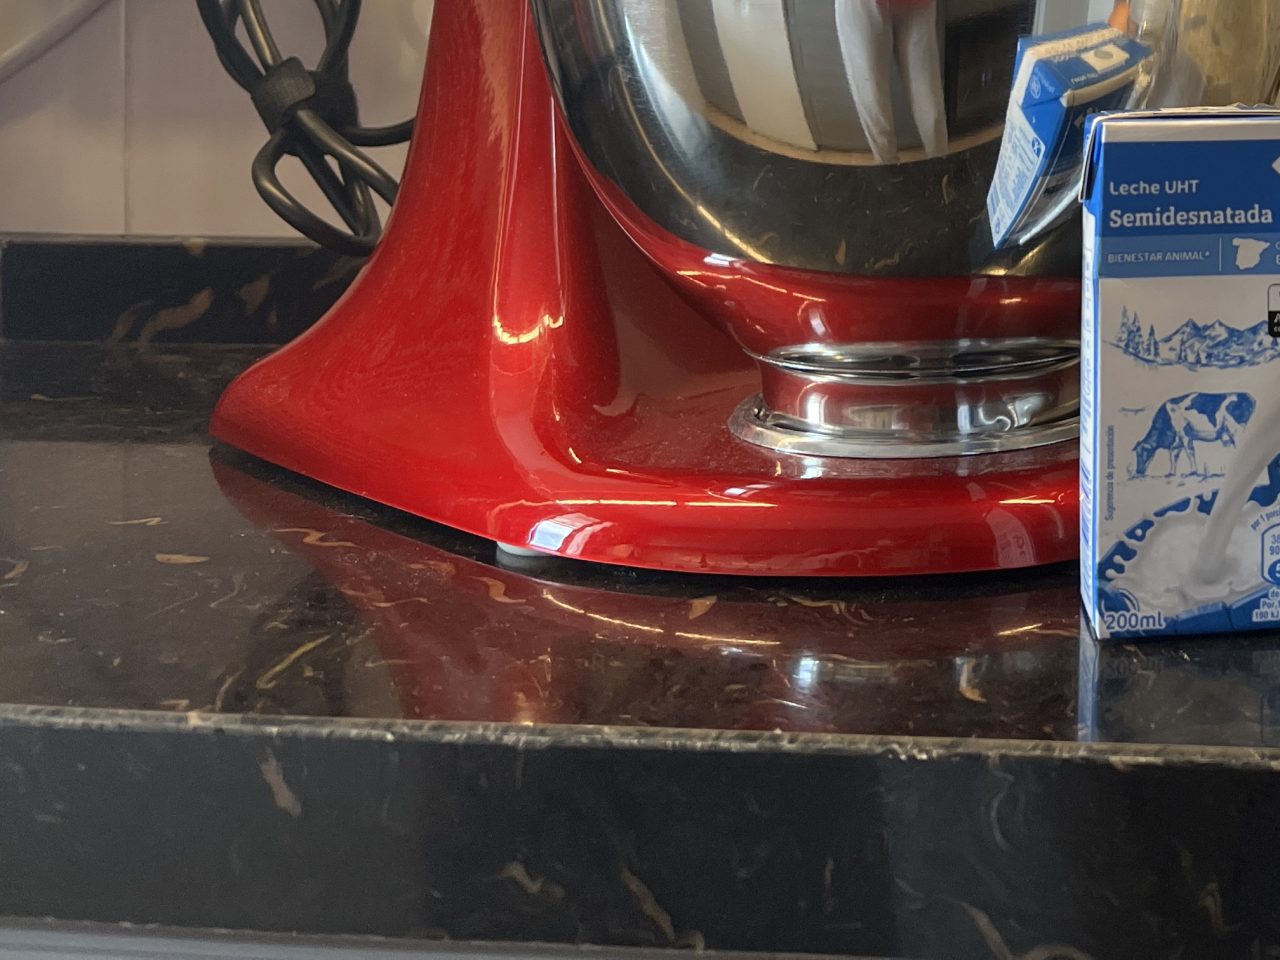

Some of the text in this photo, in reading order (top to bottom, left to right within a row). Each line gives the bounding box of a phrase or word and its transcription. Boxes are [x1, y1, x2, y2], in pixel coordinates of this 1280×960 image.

[1109, 180, 1199, 195] Leche UHT
[1109, 204, 1273, 228] Semidesnatada
[1107, 252, 1163, 263] BIENESTAR
[1270, 546, 1280, 555] 90
[1106, 613, 1164, 630] 200ml
